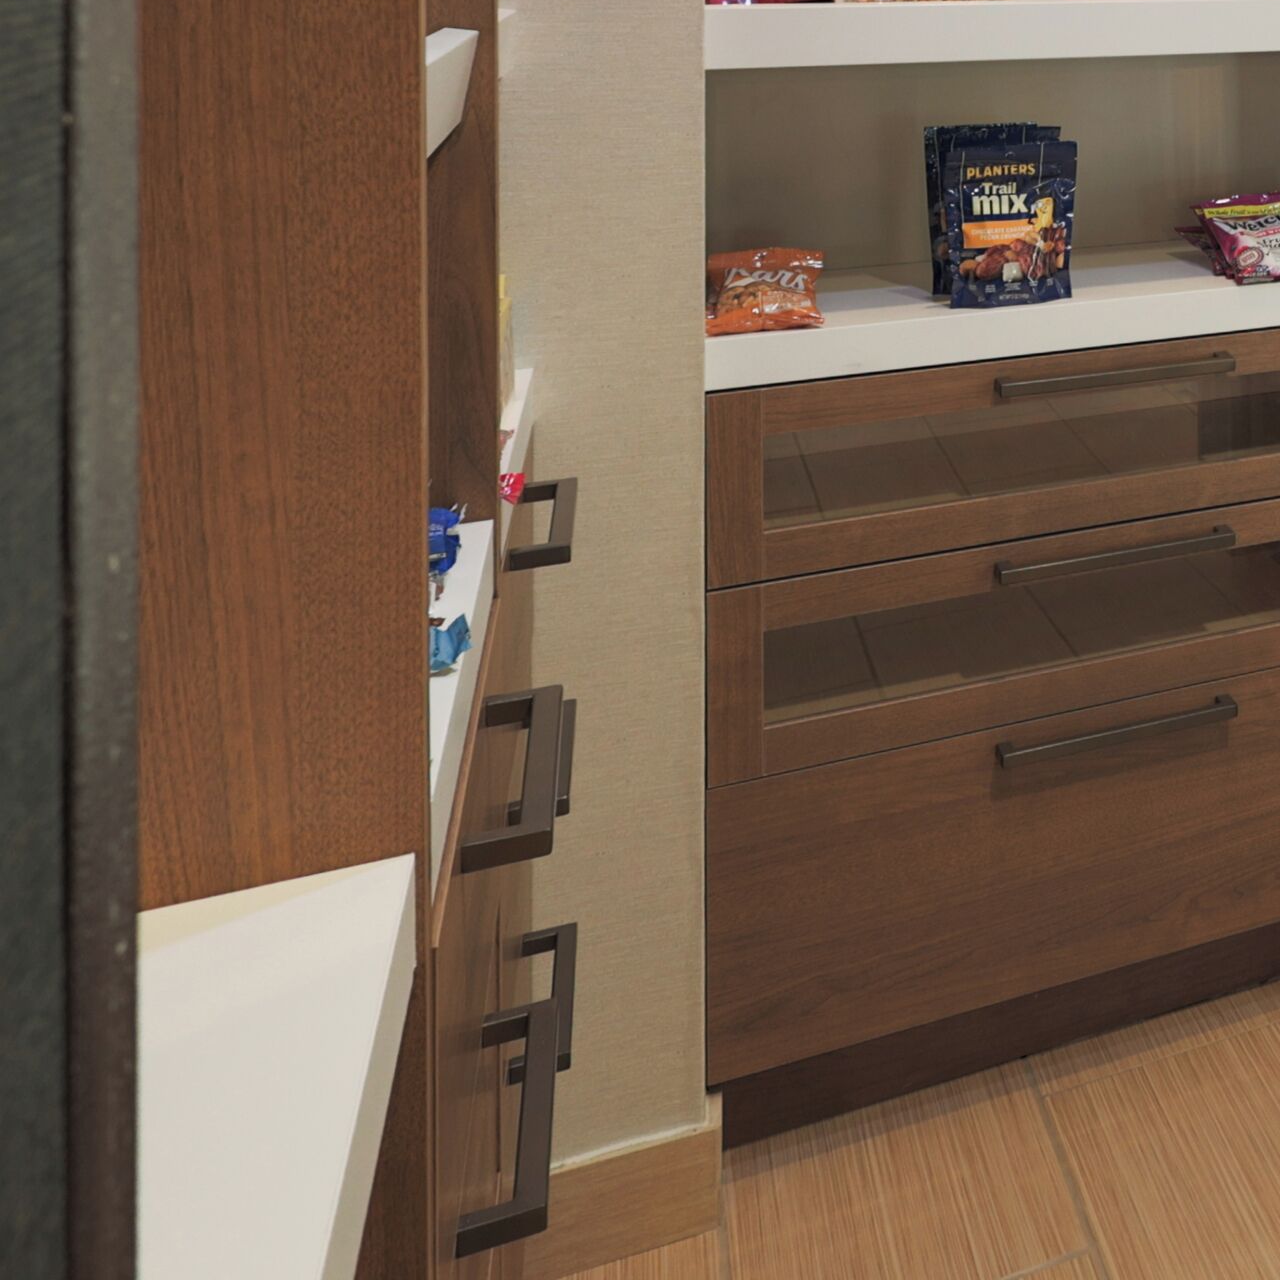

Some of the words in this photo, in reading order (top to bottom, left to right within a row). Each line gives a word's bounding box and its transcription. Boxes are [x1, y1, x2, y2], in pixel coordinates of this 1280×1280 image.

[966, 163, 1036, 181] PLANTERS
[982, 182, 1016, 195] Trail
[971, 193, 1028, 216] mix
